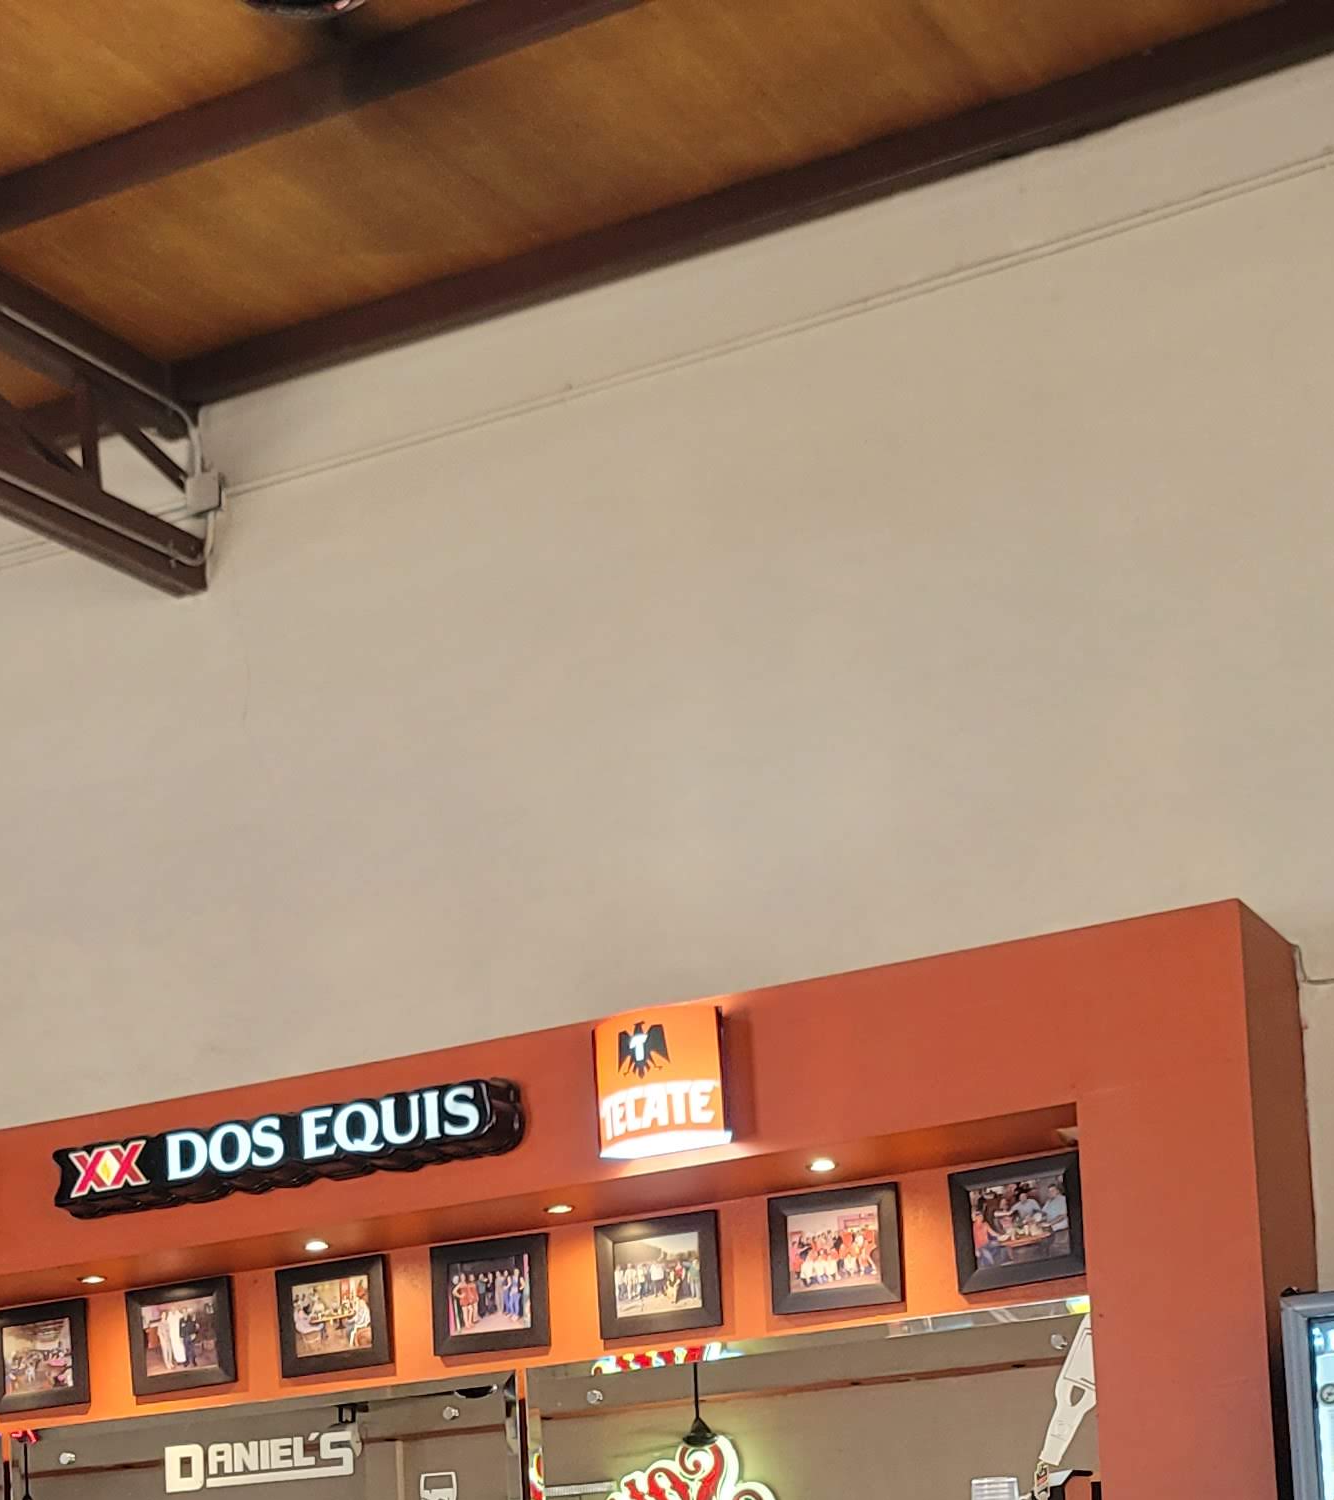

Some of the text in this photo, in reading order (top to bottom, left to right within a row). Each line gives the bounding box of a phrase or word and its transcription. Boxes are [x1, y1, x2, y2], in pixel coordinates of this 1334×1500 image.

[68, 1084, 481, 1198] XX DOS EQUIS
[601, 1080, 720, 1141] TECATE
[164, 1431, 355, 1494] DANIEL'S
